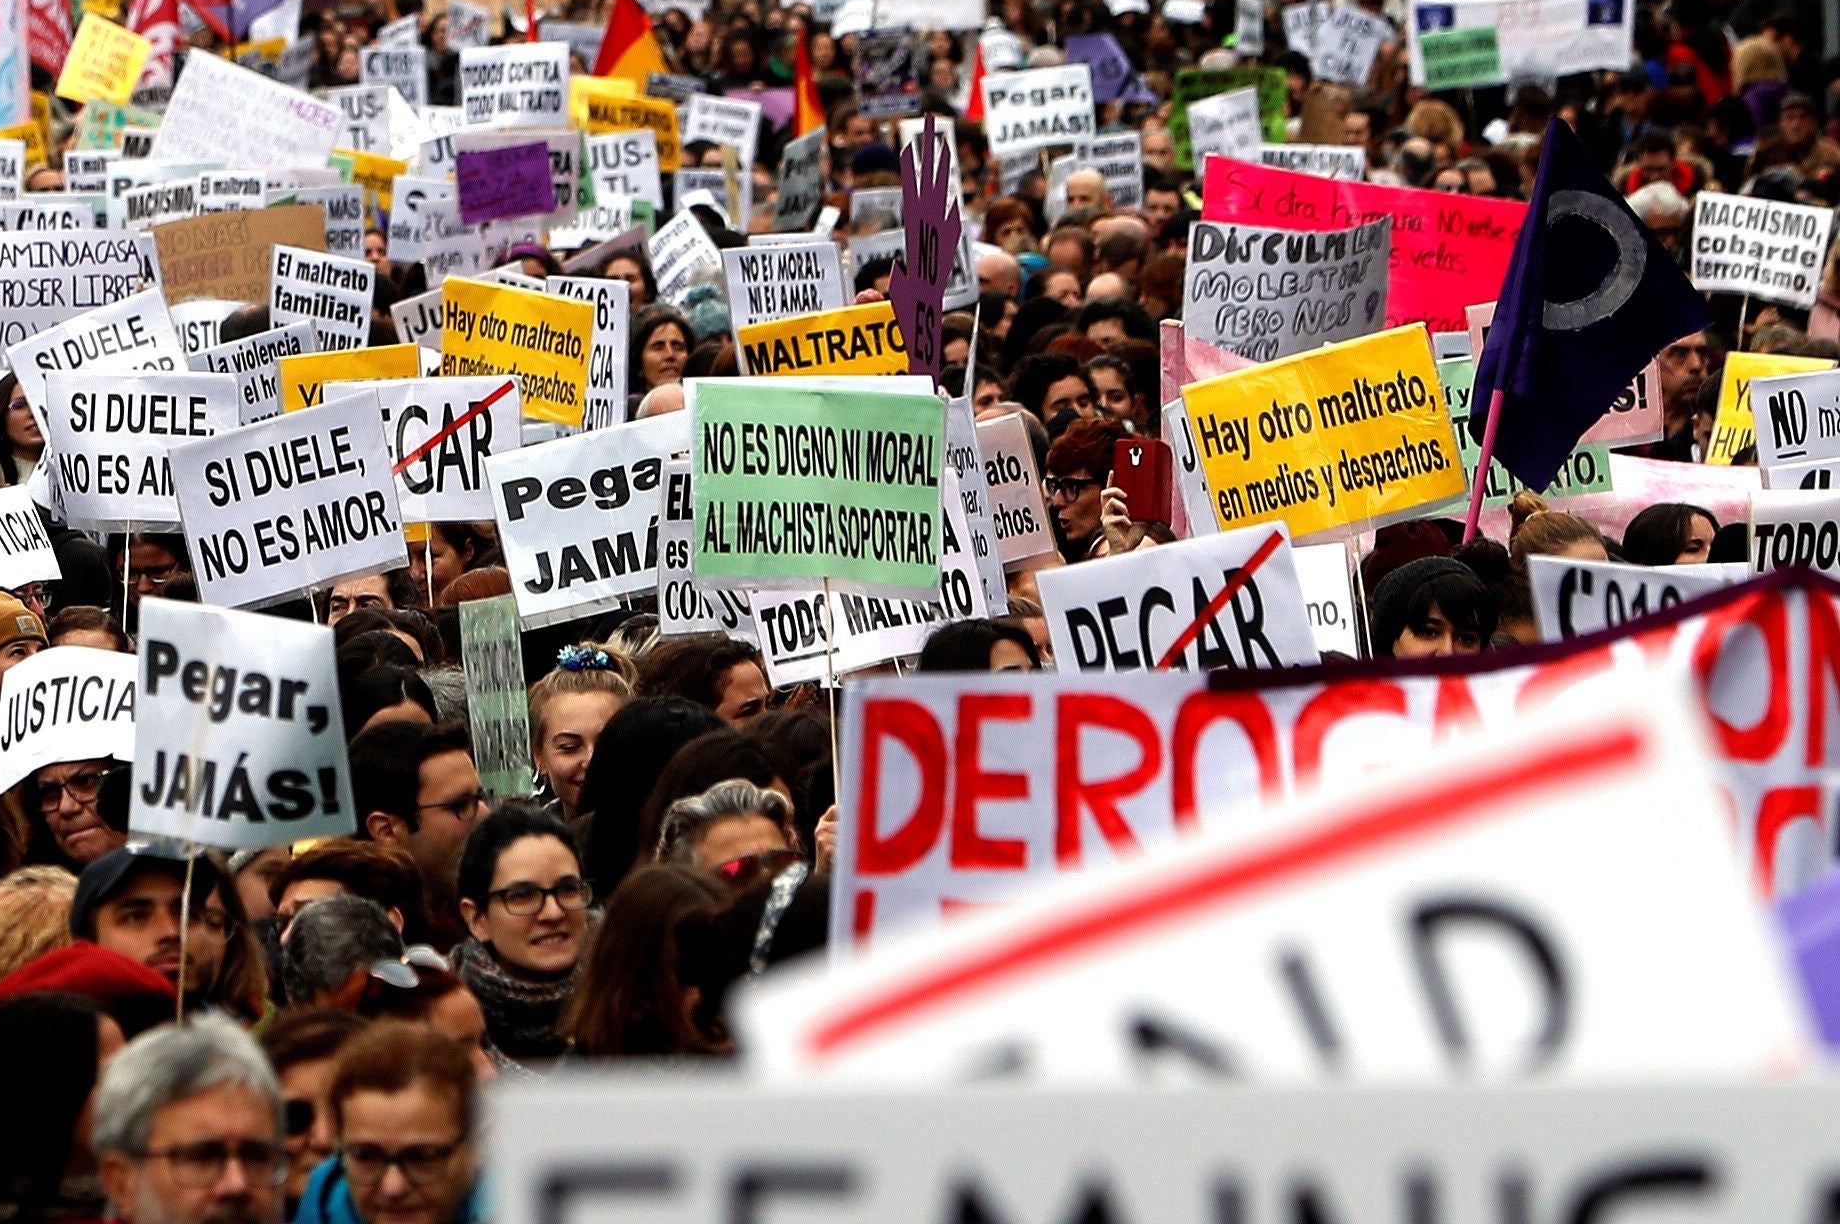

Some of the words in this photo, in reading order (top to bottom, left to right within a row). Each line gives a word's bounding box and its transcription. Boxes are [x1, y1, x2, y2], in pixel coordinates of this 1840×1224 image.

[276, 250, 292, 277] El
[296, 256, 369, 293] maltrato
[739, 254, 760, 284] NO
[777, 251, 825, 280] MORAL,
[919, 219, 938, 287] NO
[1694, 258, 1812, 293] terrorismo.
[1695, 233, 1818, 268] cobarde
[27, 279, 65, 307] SER
[274, 285, 364, 328] familiar,
[1215, 302, 1284, 338] PERO
[1292, 293, 1356, 336] NOS
[63, 315, 157, 370] DUELE,
[231, 332, 302, 374] violencia
[445, 300, 475, 342] Hay
[479, 315, 507, 344] otro
[511, 321, 586, 365] maltrato,
[743, 318, 904, 376] MALTRATO
[914, 301, 935, 366] ES
[70, 392, 96, 432] SI
[244, 385, 261, 405] el
[1198, 412, 1253, 459] Hay
[1258, 398, 1313, 444] otro
[1321, 368, 1437, 430] maltrato,
[1768, 389, 1807, 450] NO
[59, 453, 89, 494] NO
[98, 454, 130, 494] ES
[204, 461, 242, 507] SI
[244, 425, 366, 499] DUELE,
[703, 422, 736, 476] NO
[742, 422, 769, 476] ES
[775, 425, 836, 478] DIGNO
[841, 428, 861, 482] NI
[865, 428, 938, 487] MORAL
[1217, 485, 1246, 523] en
[1245, 466, 1317, 513] medios
[1322, 468, 1337, 508] y
[1340, 435, 1451, 494] despachos.
[198, 526, 249, 583] NO
[258, 513, 301, 568] ES
[303, 489, 398, 554] AMOR.
[703, 500, 731, 554] AL
[736, 502, 837, 556] MACHISTA
[838, 504, 937, 565] SOPORTAR.
[760, 593, 836, 656] TODO
[144, 638, 330, 737] Pegar,
[139, 749, 340, 824] JAMÁS!
